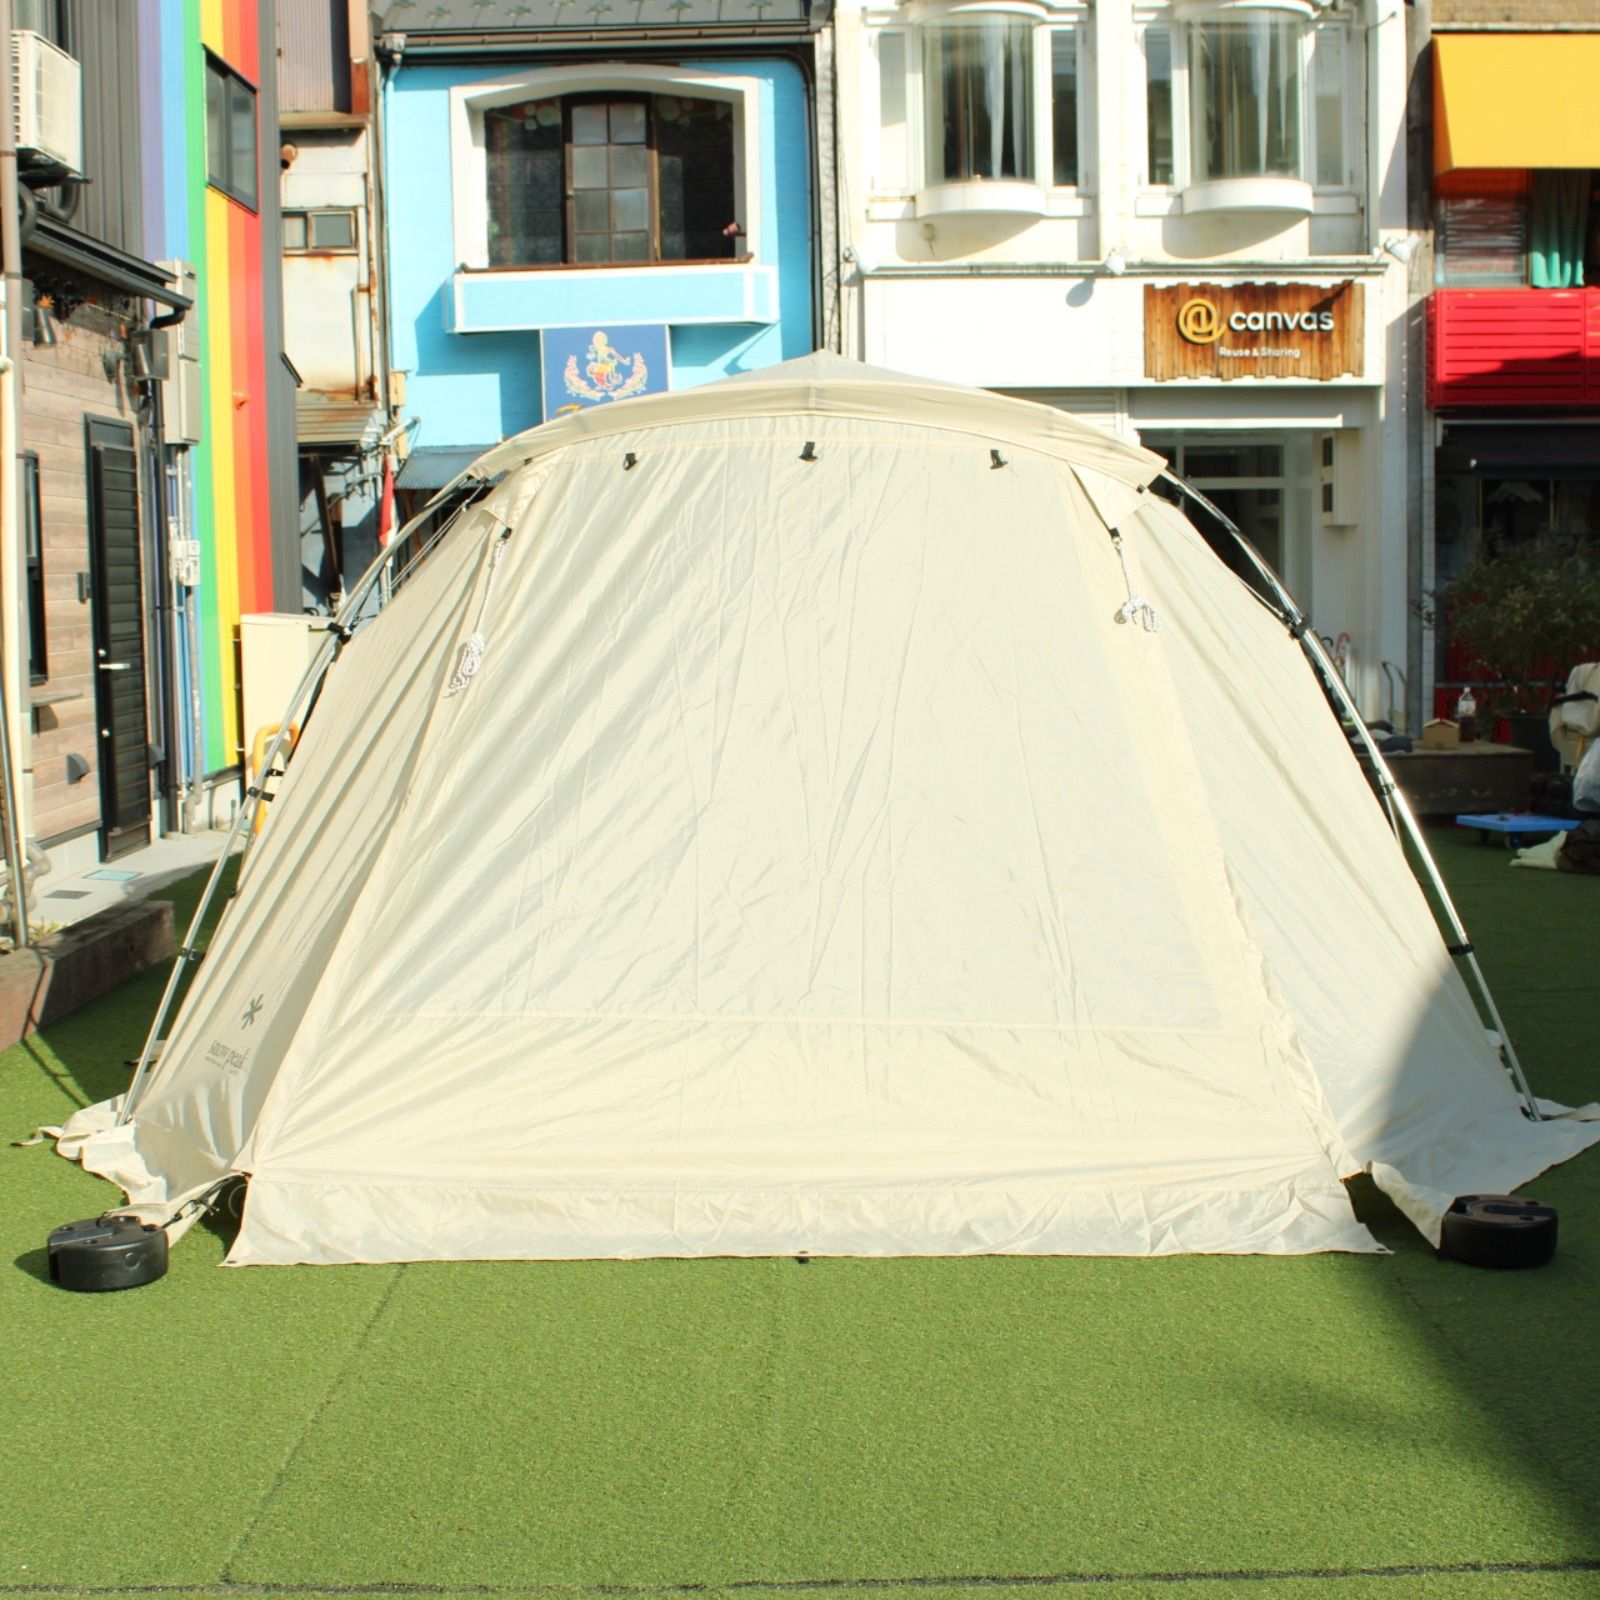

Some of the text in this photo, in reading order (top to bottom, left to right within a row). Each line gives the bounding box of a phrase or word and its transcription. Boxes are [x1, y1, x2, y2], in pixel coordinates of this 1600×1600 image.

[1219, 347, 1301, 359] Reuse & Sharing
